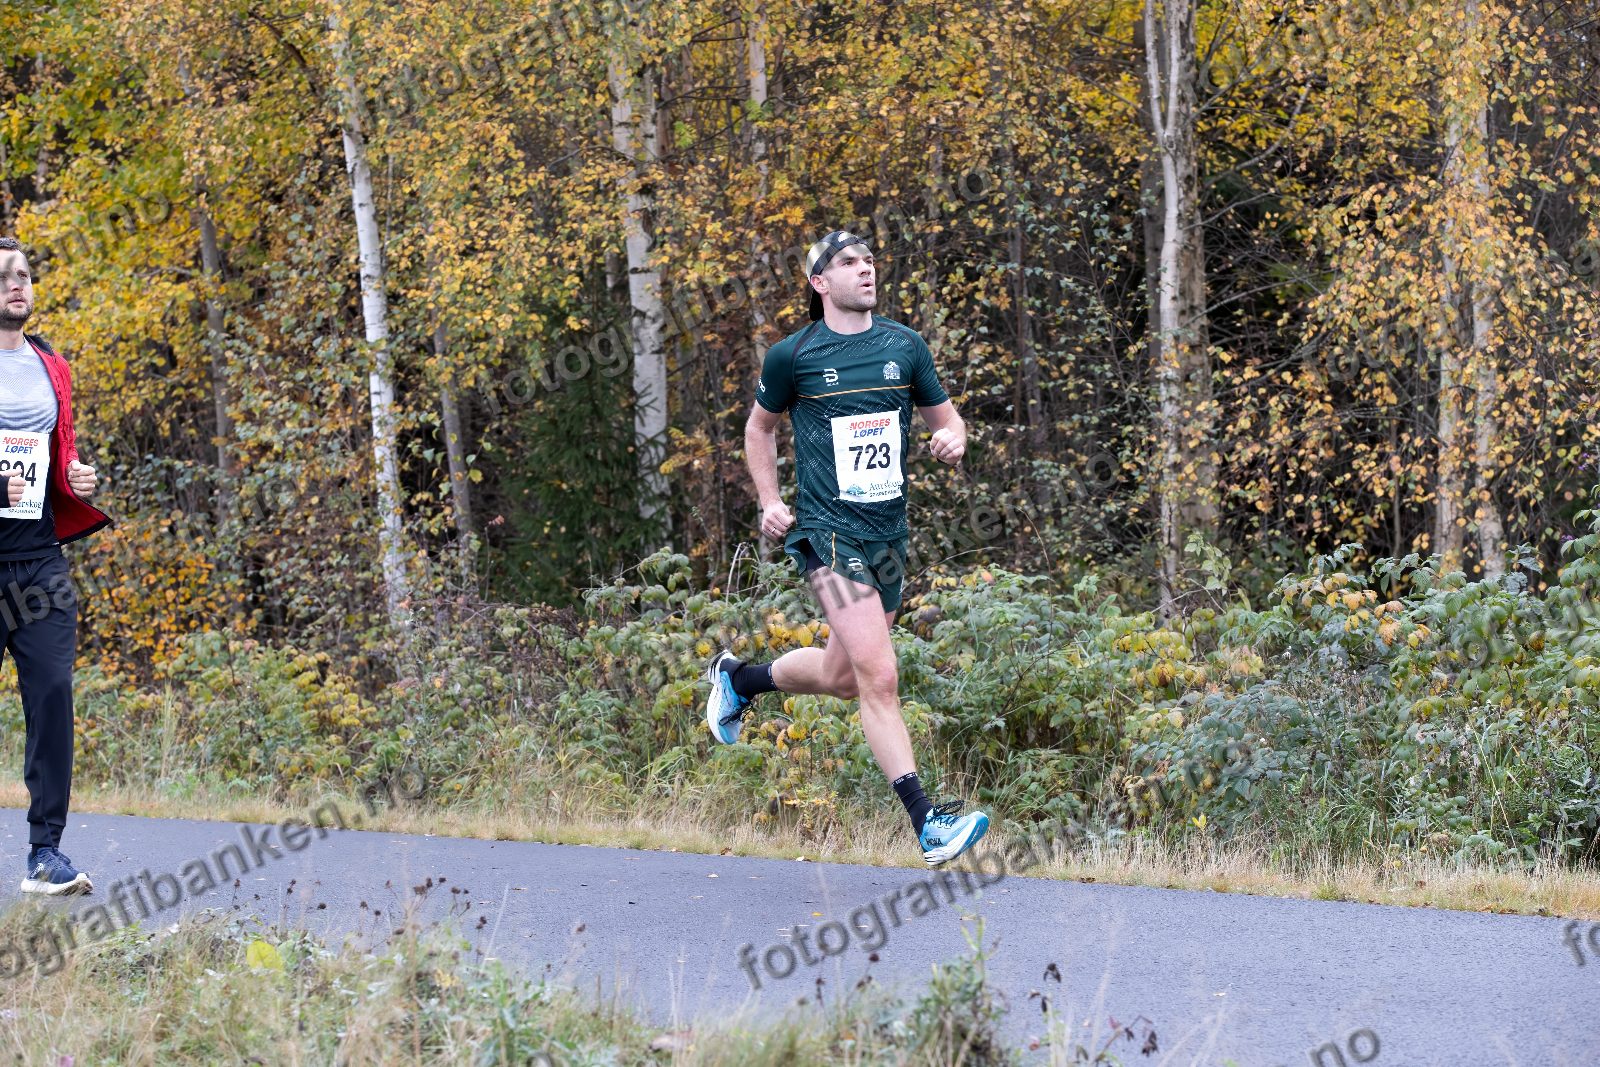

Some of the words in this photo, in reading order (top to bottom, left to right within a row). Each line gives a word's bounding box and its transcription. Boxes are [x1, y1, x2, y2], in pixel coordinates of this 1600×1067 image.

[850, 418, 891, 431] NORGES
[853, 427, 885, 438] LØPET
[3, 437, 39, 446] NORGES
[5, 445, 34, 454] LØPET
[849, 443, 891, 471] 723
